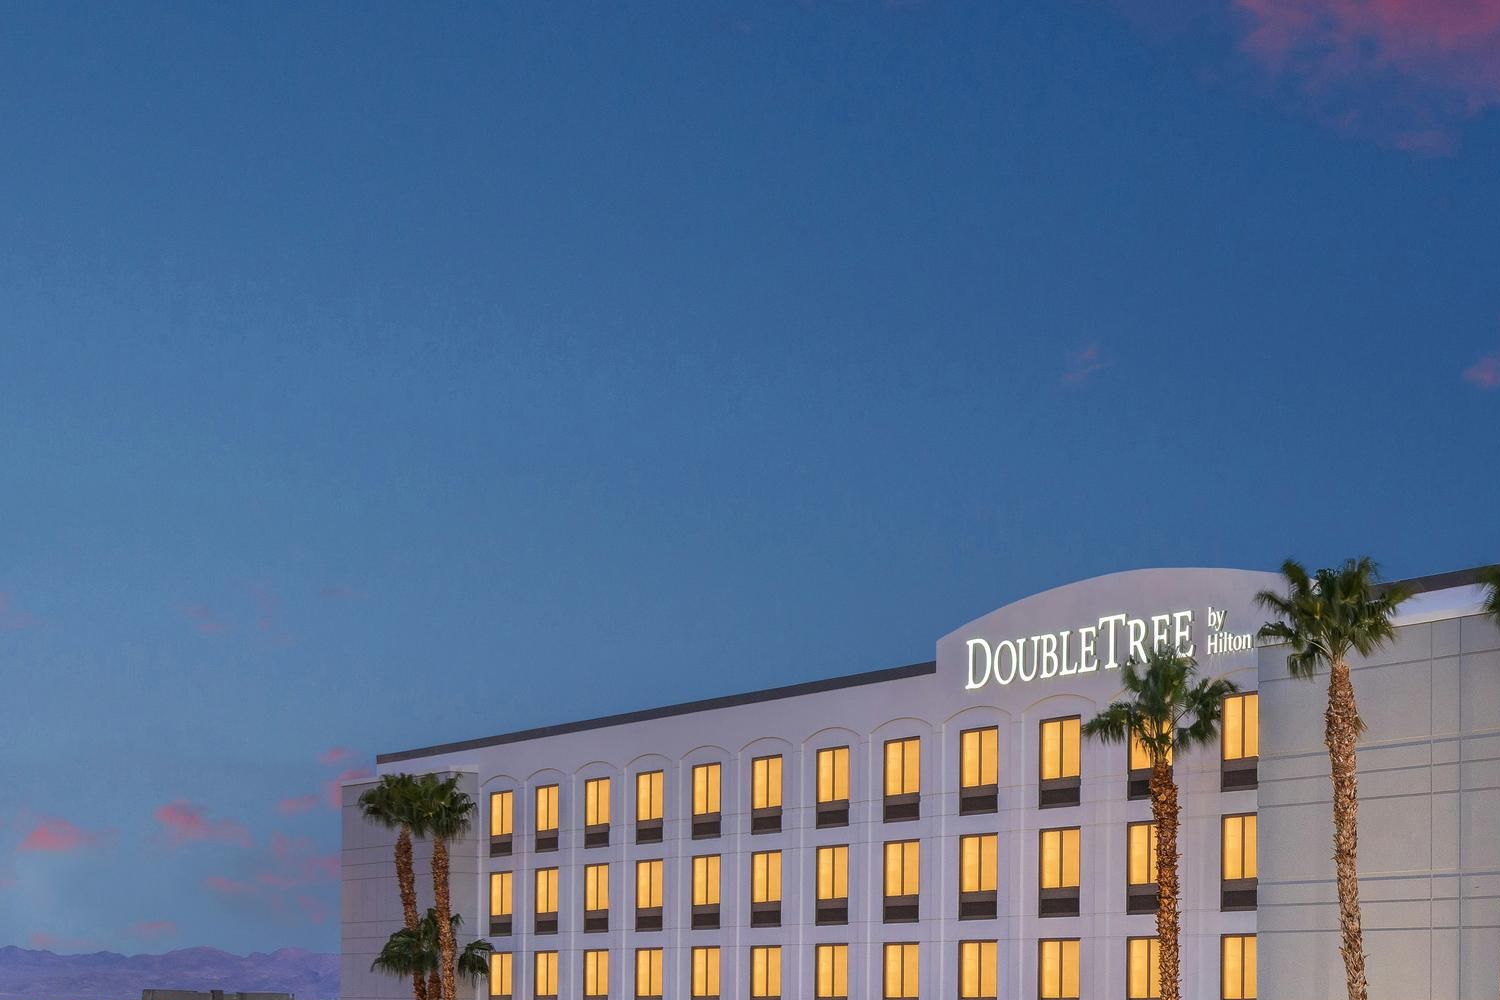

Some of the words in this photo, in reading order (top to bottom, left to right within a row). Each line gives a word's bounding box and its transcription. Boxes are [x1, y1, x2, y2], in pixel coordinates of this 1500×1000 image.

[1207, 606, 1226, 632] by
[965, 609, 1195, 690] DOUBLETREE
[1207, 631, 1252, 655] Hilton
